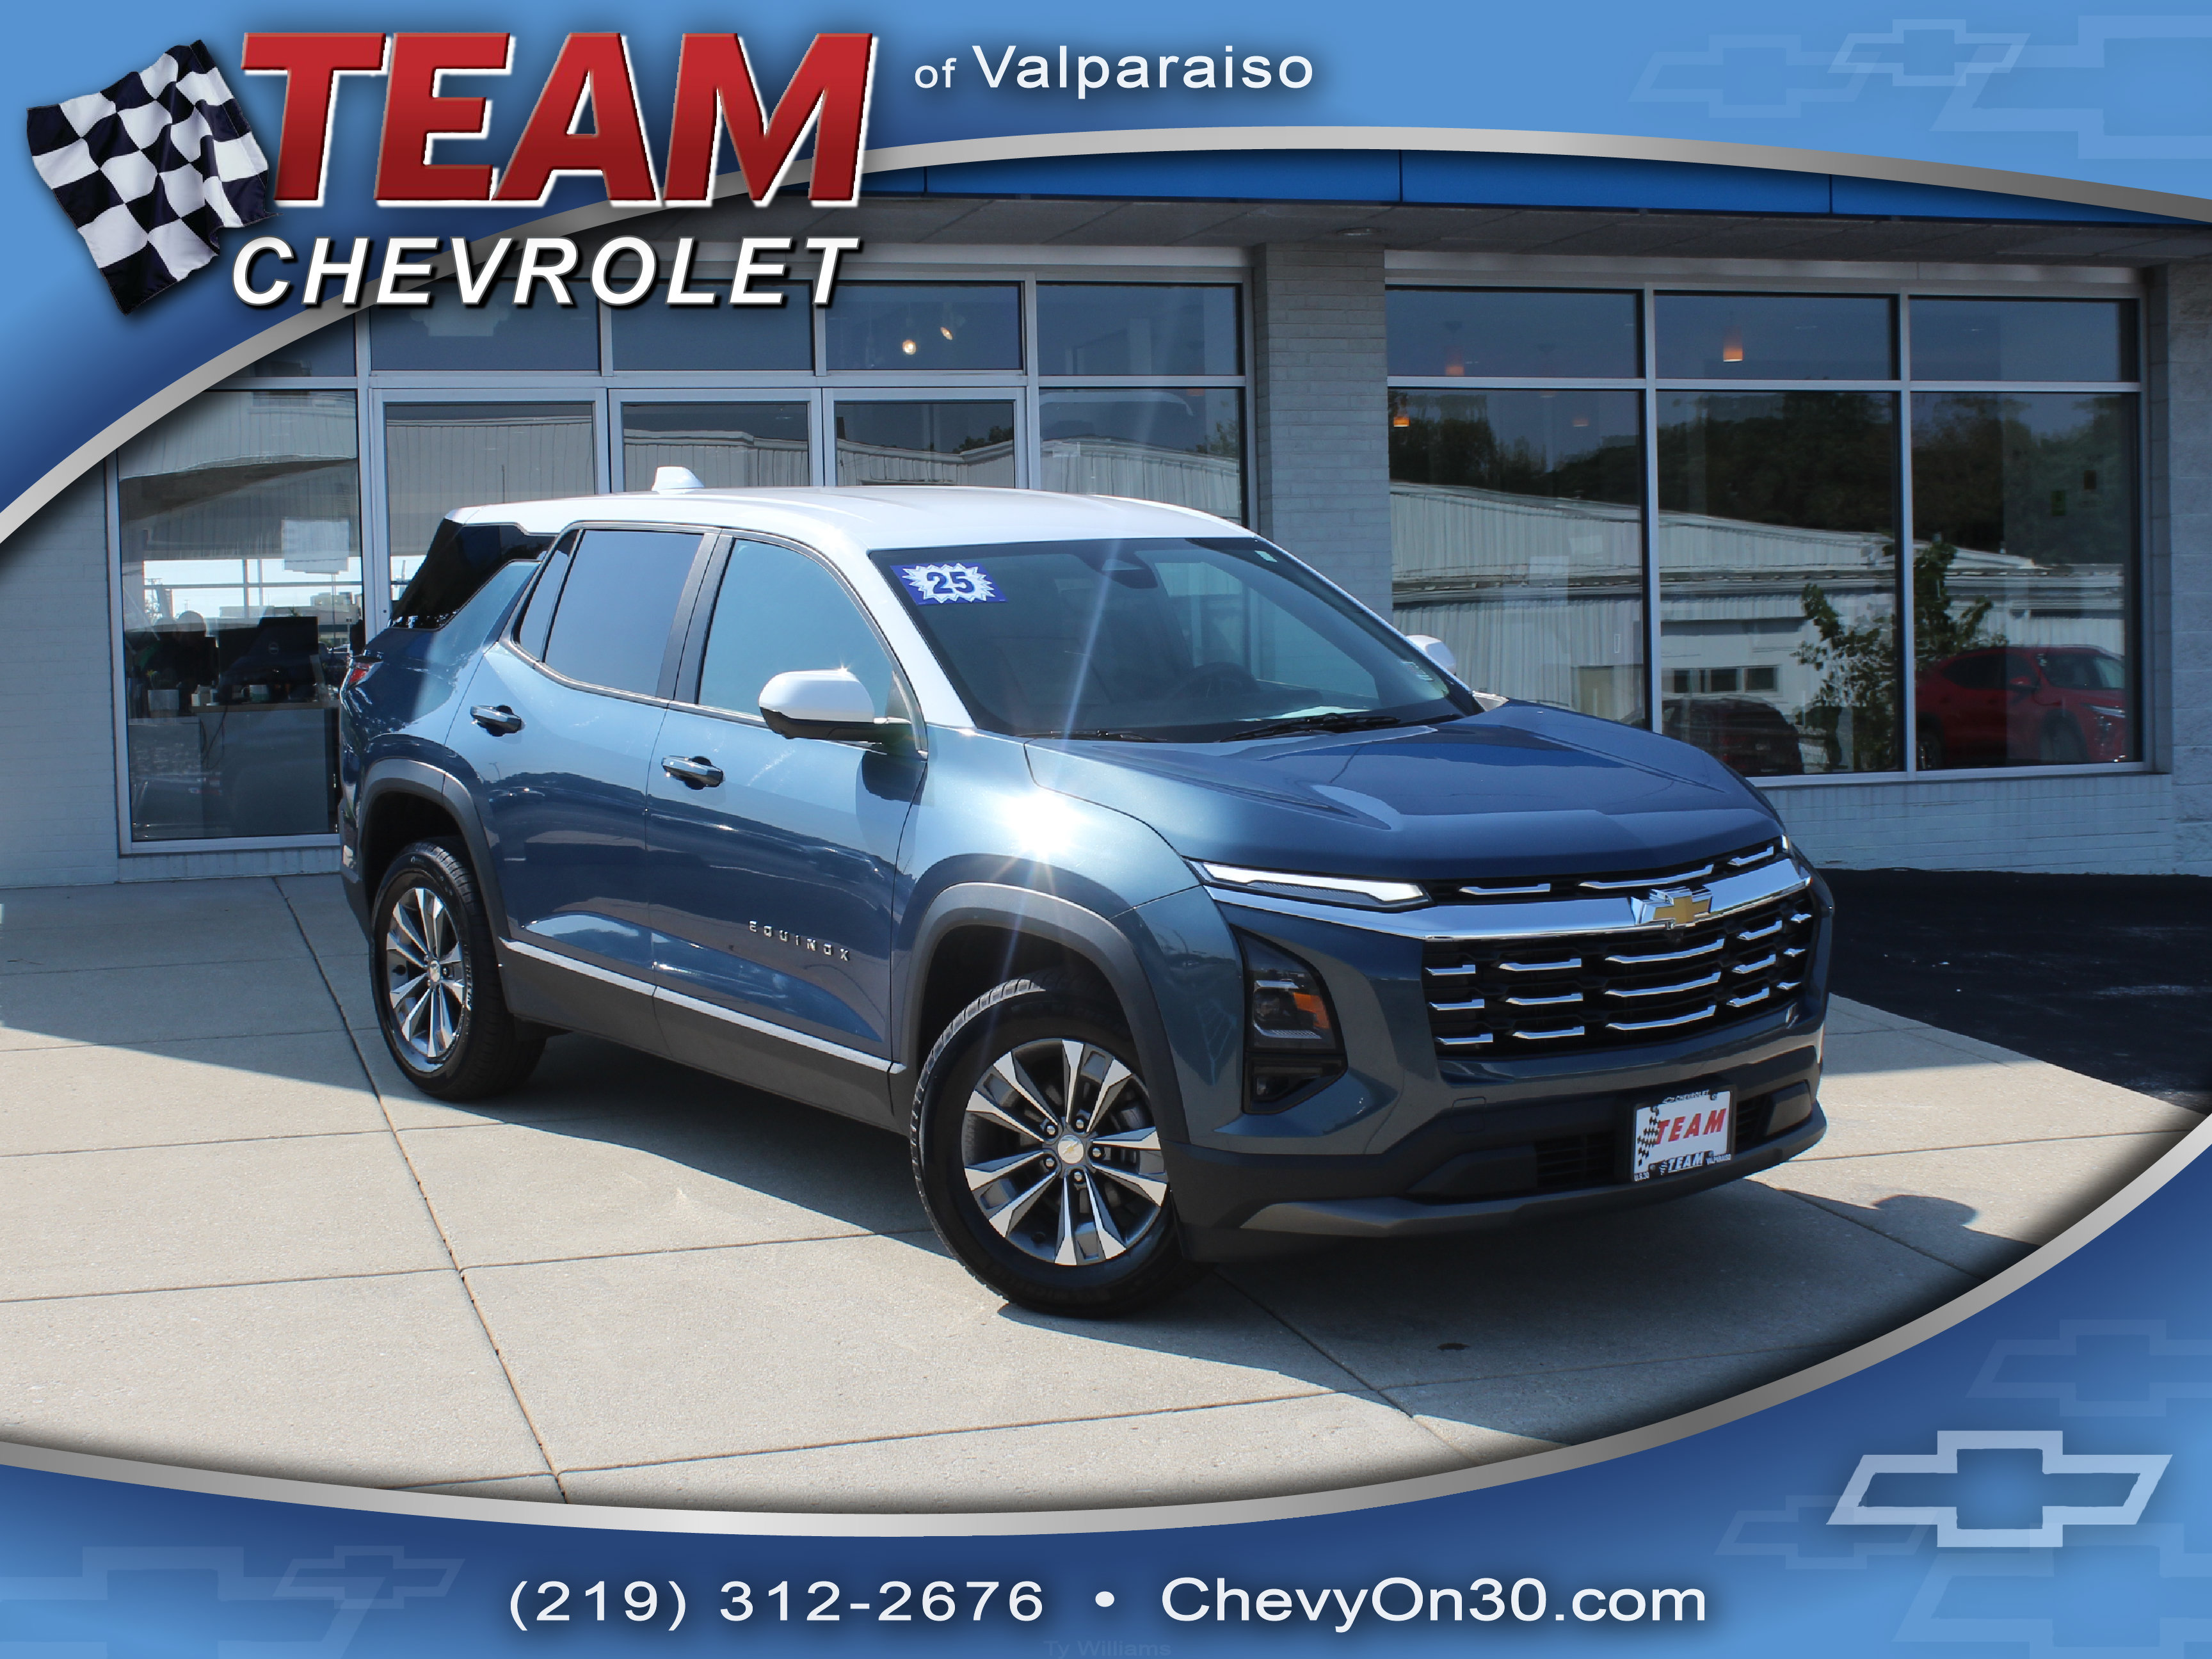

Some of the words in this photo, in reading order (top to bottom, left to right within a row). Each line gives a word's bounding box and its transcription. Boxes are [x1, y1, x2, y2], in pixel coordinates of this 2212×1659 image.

[926, 571, 975, 594] 25
[748, 919, 851, 961] EQUINOX
[1655, 1109, 1726, 1144] TEAM
[1668, 1152, 1704, 1173] TEAM
